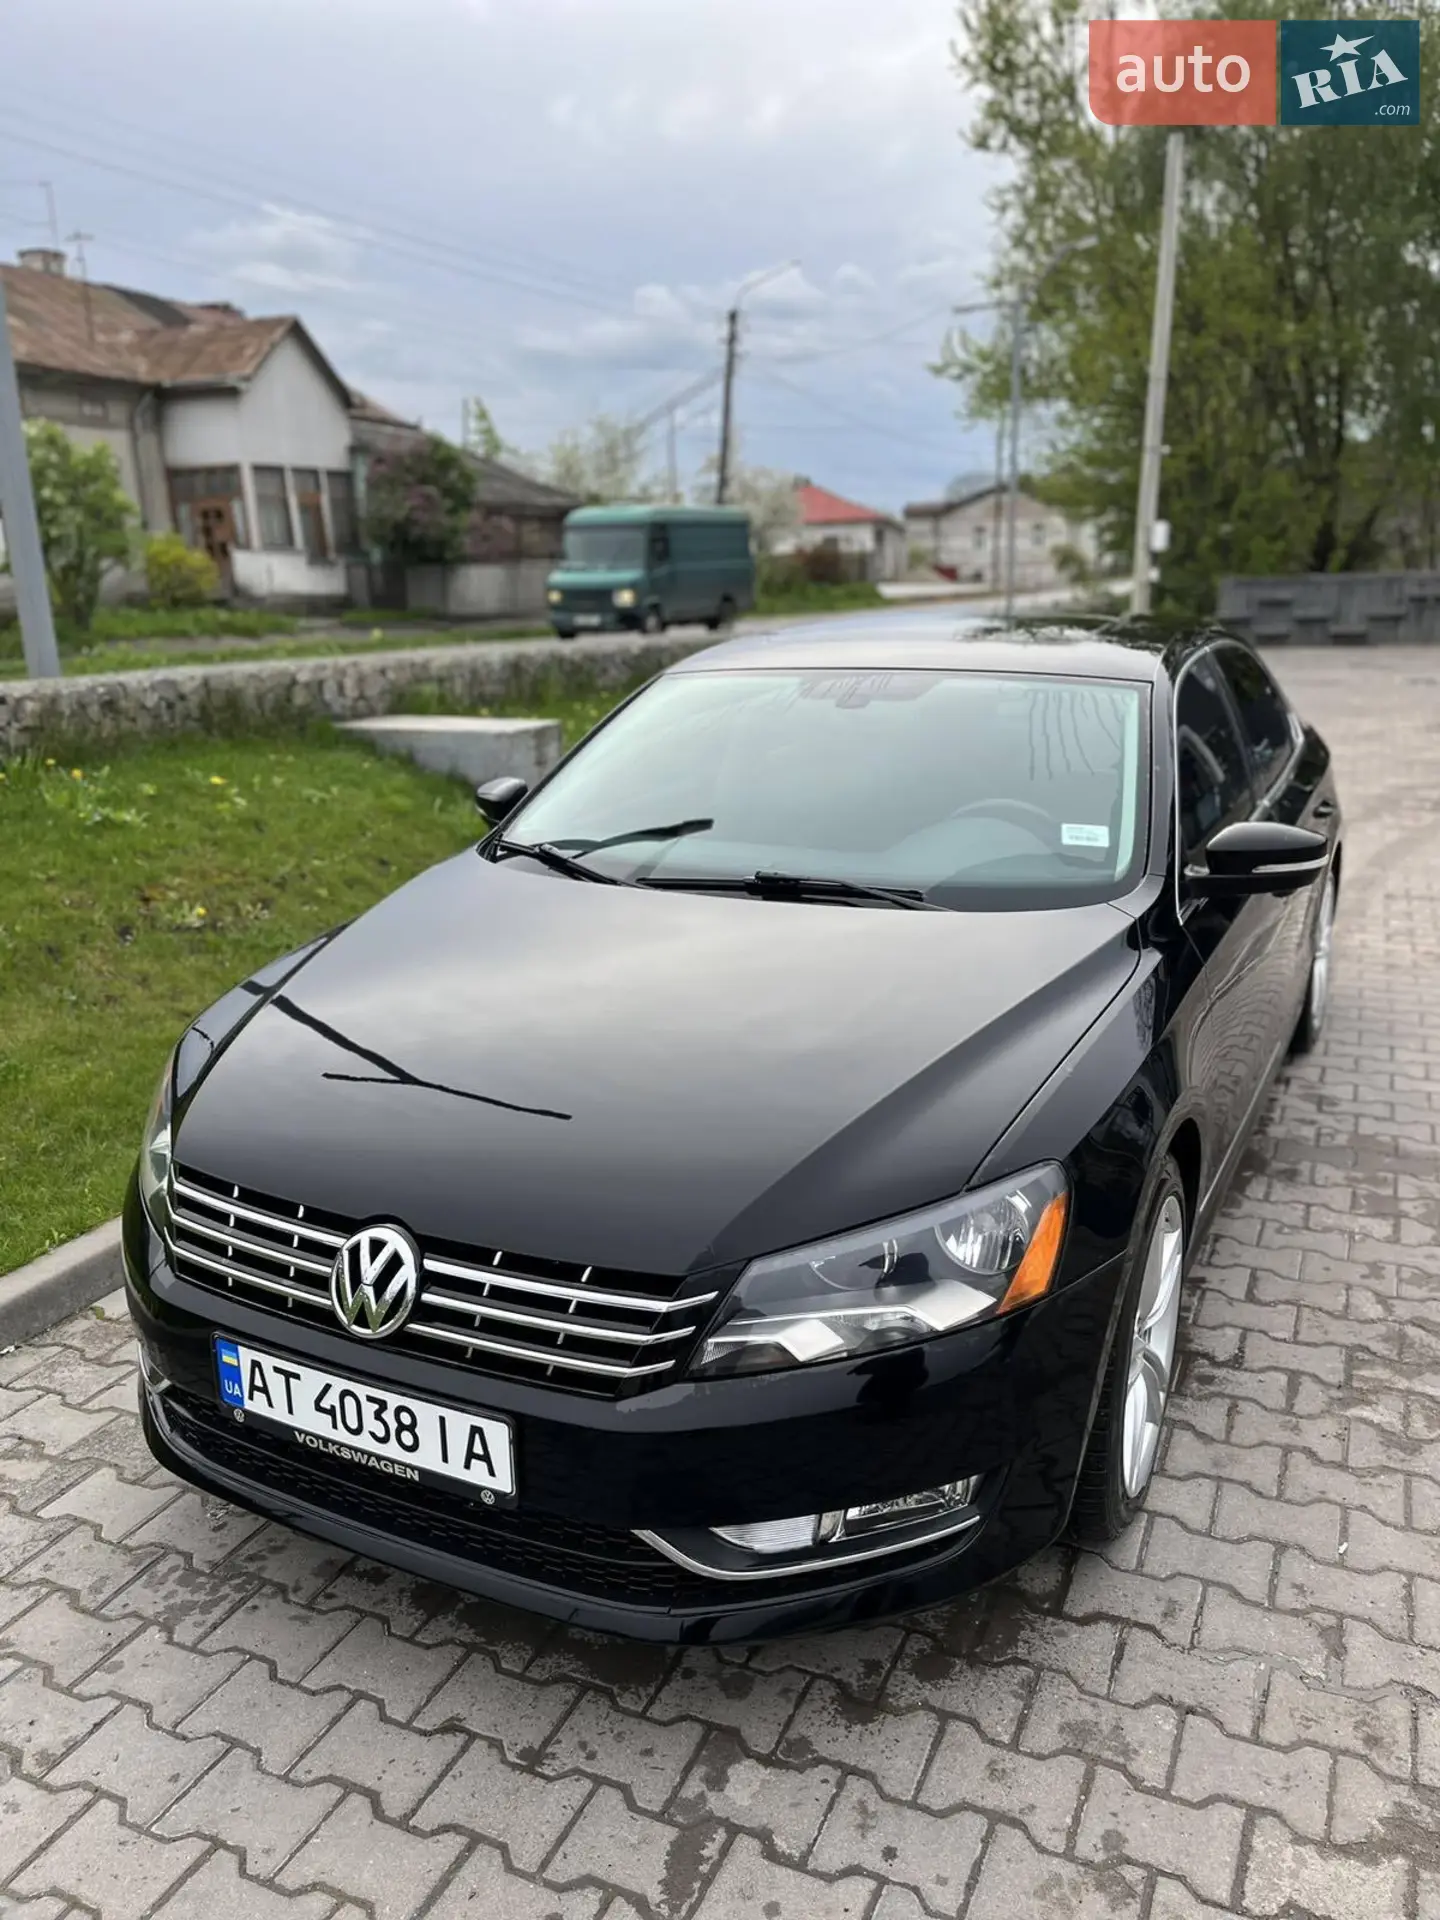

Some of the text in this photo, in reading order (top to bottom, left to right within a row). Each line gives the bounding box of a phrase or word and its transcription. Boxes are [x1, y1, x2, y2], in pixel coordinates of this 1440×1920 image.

[224, 1379, 242, 1398] UA
[248, 1359, 497, 1477] AT 4038 IA
[295, 1431, 420, 1482] VOLKSWAGEN
